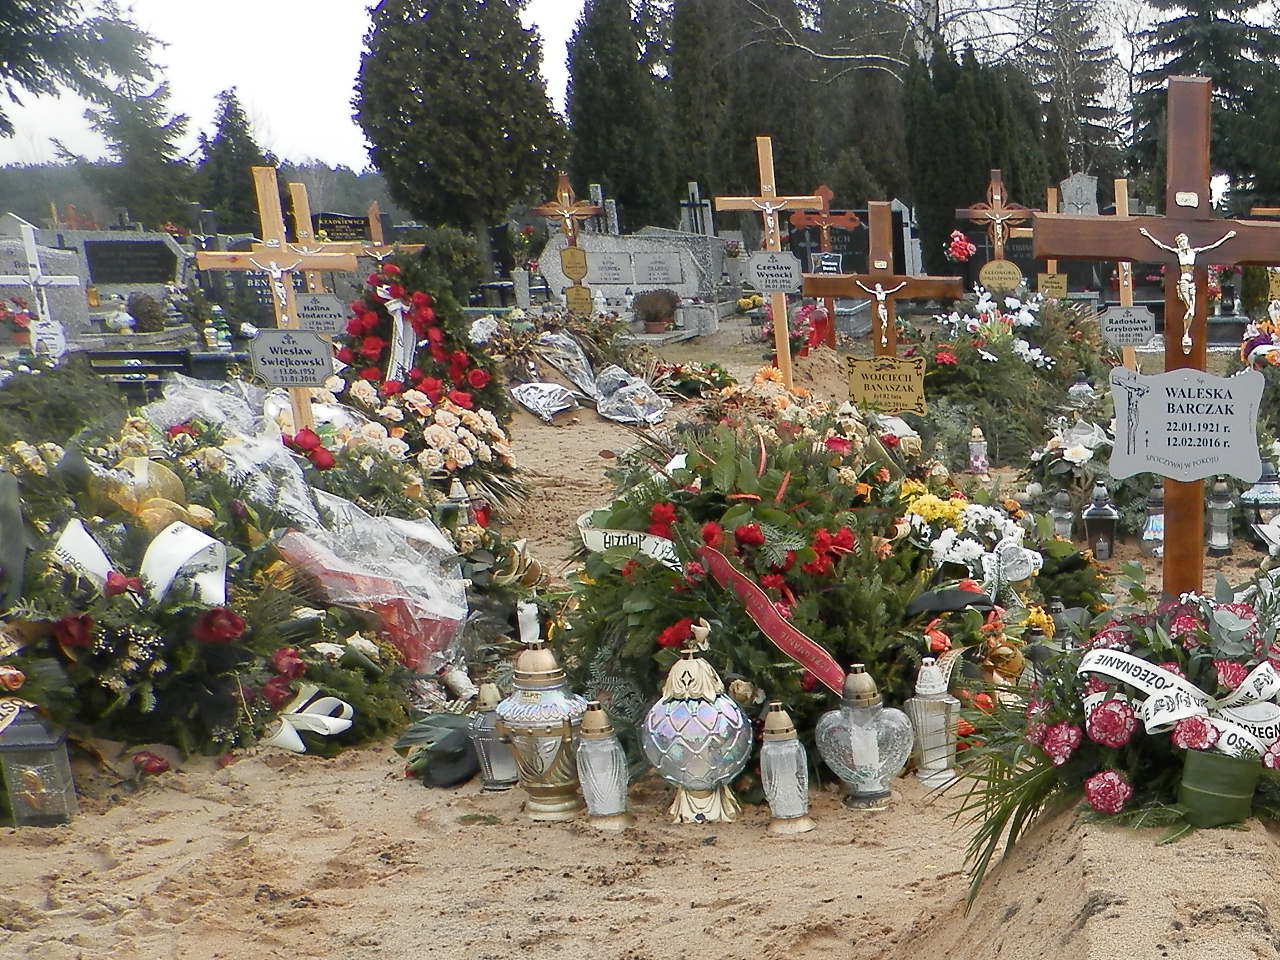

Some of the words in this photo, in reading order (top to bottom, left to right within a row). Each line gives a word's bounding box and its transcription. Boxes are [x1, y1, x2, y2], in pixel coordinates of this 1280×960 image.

[756, 271, 793, 279] Wysocki
[269, 346, 312, 355] Wiesław
[261, 356, 325, 368] Świejkowski
[861, 373, 911, 382] WOJCIECH
[863, 383, 914, 393] BANASZAK
[1165, 387, 1233, 400] WALESKA
[1167, 403, 1234, 416] BARCZAK
[1166, 422, 1219, 433] 22.01.1921
[1167, 437, 1220, 448] 12.02.2016
[1146, 454, 1182, 470] SPOCZYWAJ
[1192, 455, 1220, 467] POKOJU
